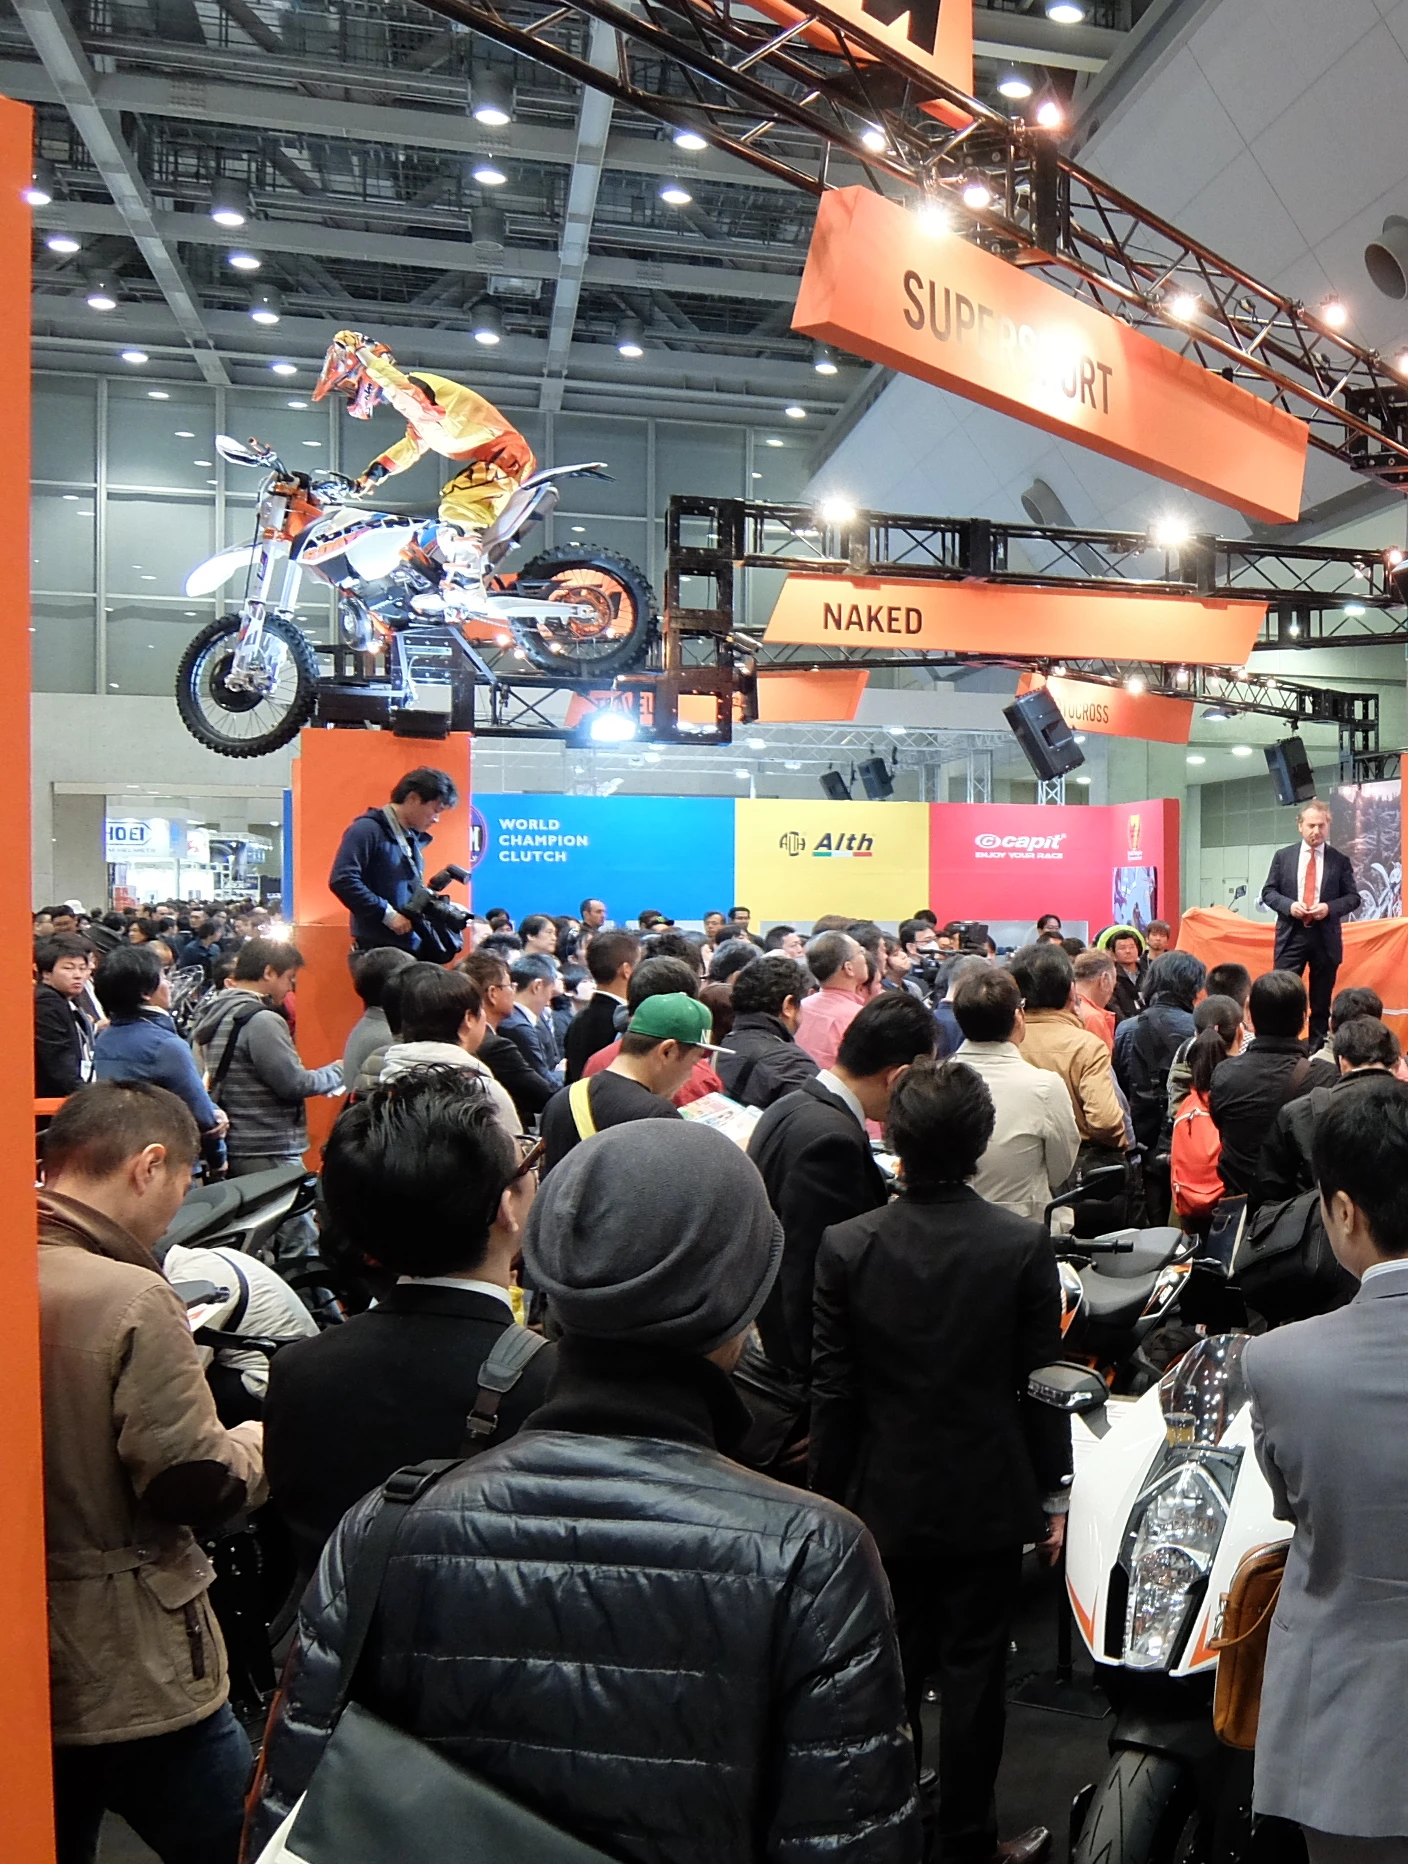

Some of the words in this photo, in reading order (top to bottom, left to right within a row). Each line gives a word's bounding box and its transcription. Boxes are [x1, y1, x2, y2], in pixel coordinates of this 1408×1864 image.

[903, 269, 1113, 415] SUPERSORT
[823, 602, 922, 635] NAKED
[1057, 699, 1109, 723] TOCROSS
[499, 819, 560, 830] WORLD
[106, 826, 144, 841] HOEI
[499, 834, 589, 846] CHAMPION
[813, 832, 874, 851] Alth
[499, 850, 567, 862] CLUTCH
[975, 851, 1006, 859] ENJOY
